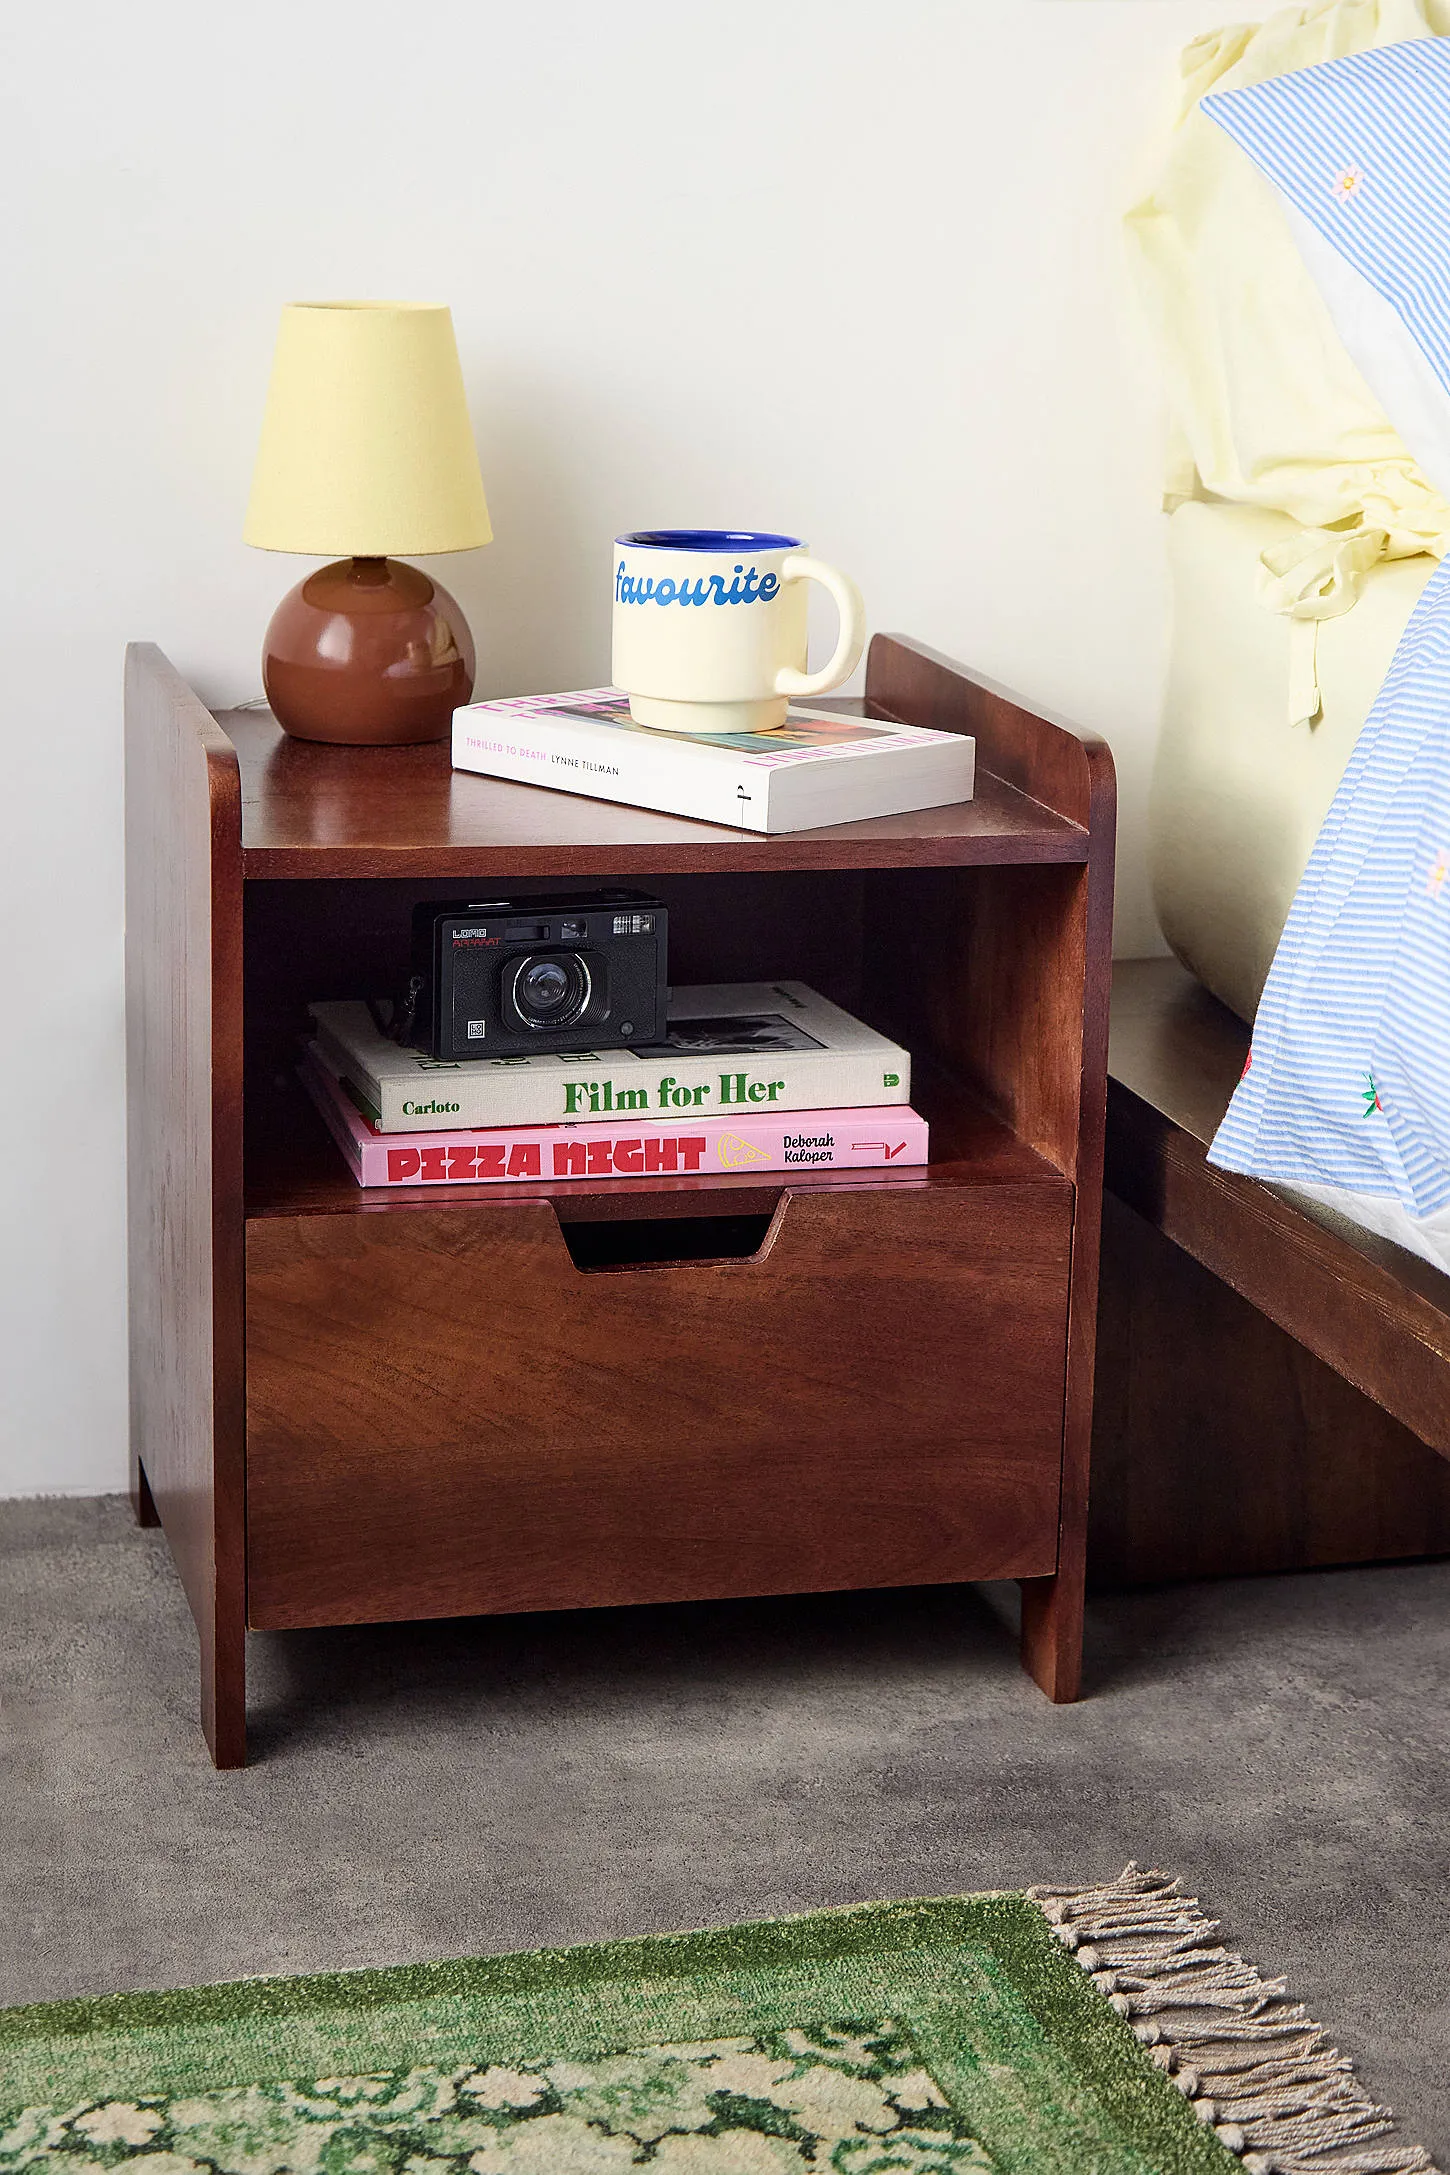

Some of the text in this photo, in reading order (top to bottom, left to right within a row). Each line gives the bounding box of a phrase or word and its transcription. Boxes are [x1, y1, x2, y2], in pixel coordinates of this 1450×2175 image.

[616, 561, 781, 607] favourite
[471, 689, 629, 712] THRILL
[466, 737, 547, 761] THRILLED TO DEATH
[551, 754, 619, 776] LYNNE TILLMAN
[452, 928, 487, 939] LOMO
[562, 1072, 786, 1114] Film for Her
[402, 1099, 461, 1116] Carloto
[783, 1133, 835, 1149] Deborah
[387, 1143, 542, 1182] PIZZA
[784, 1149, 834, 1165] Kaloper
